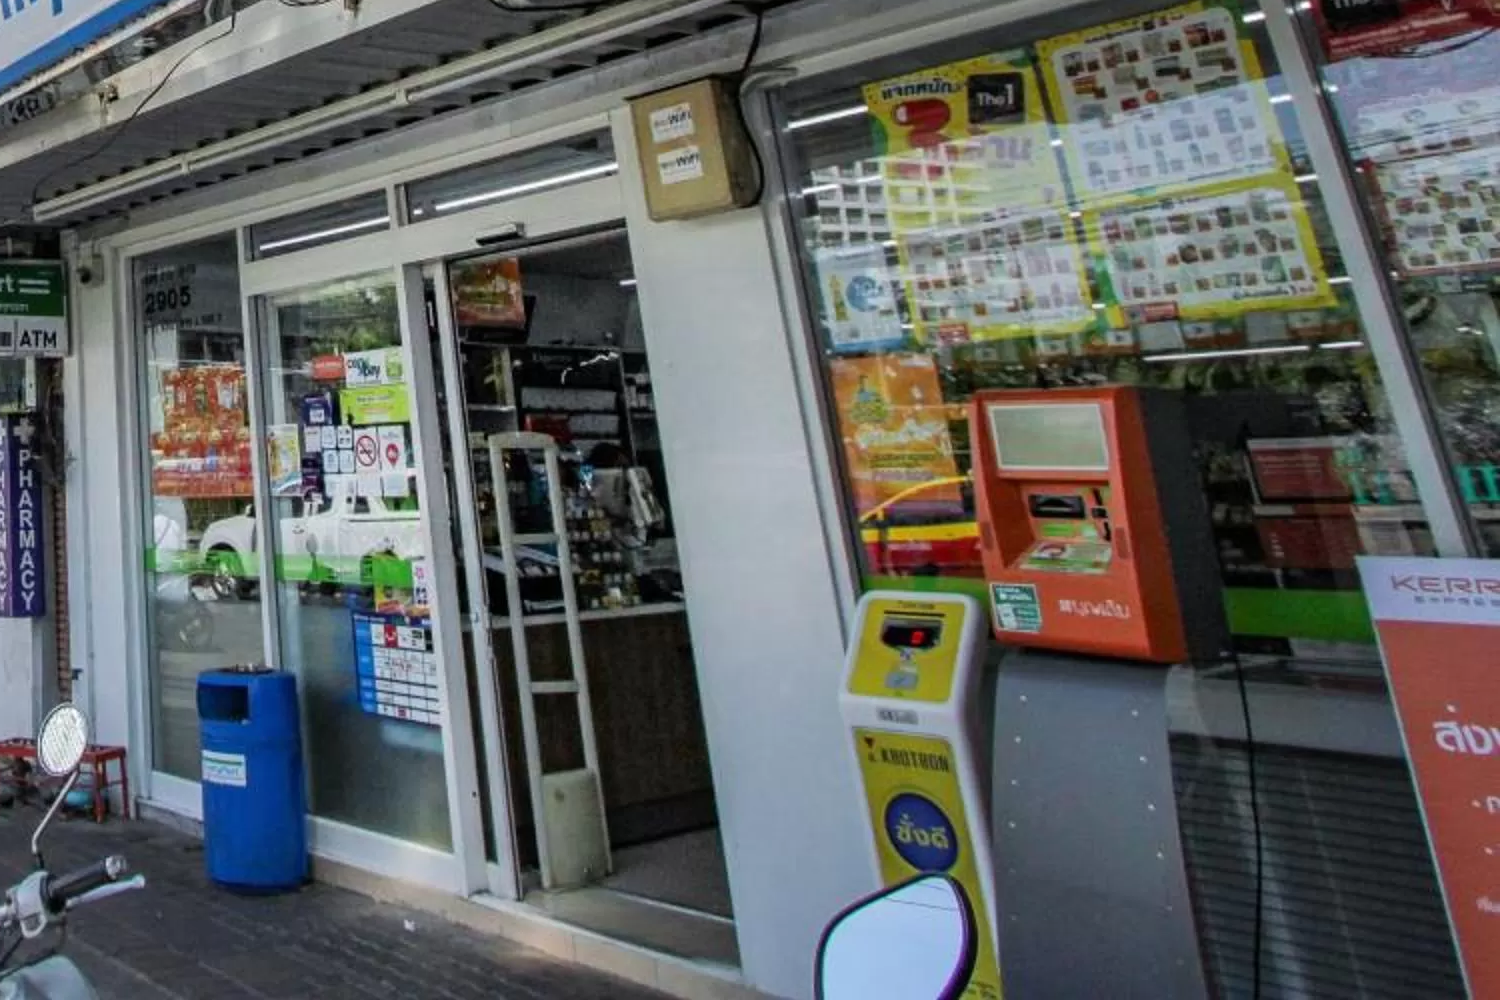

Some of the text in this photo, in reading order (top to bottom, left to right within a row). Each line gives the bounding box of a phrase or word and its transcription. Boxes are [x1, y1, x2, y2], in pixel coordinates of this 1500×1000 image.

[145, 286, 191, 316] 2905
[19, 331, 57, 349] ATM
[18, 450, 36, 611] PHARMACY
[1434, 704, 1500, 756] ส่ง
